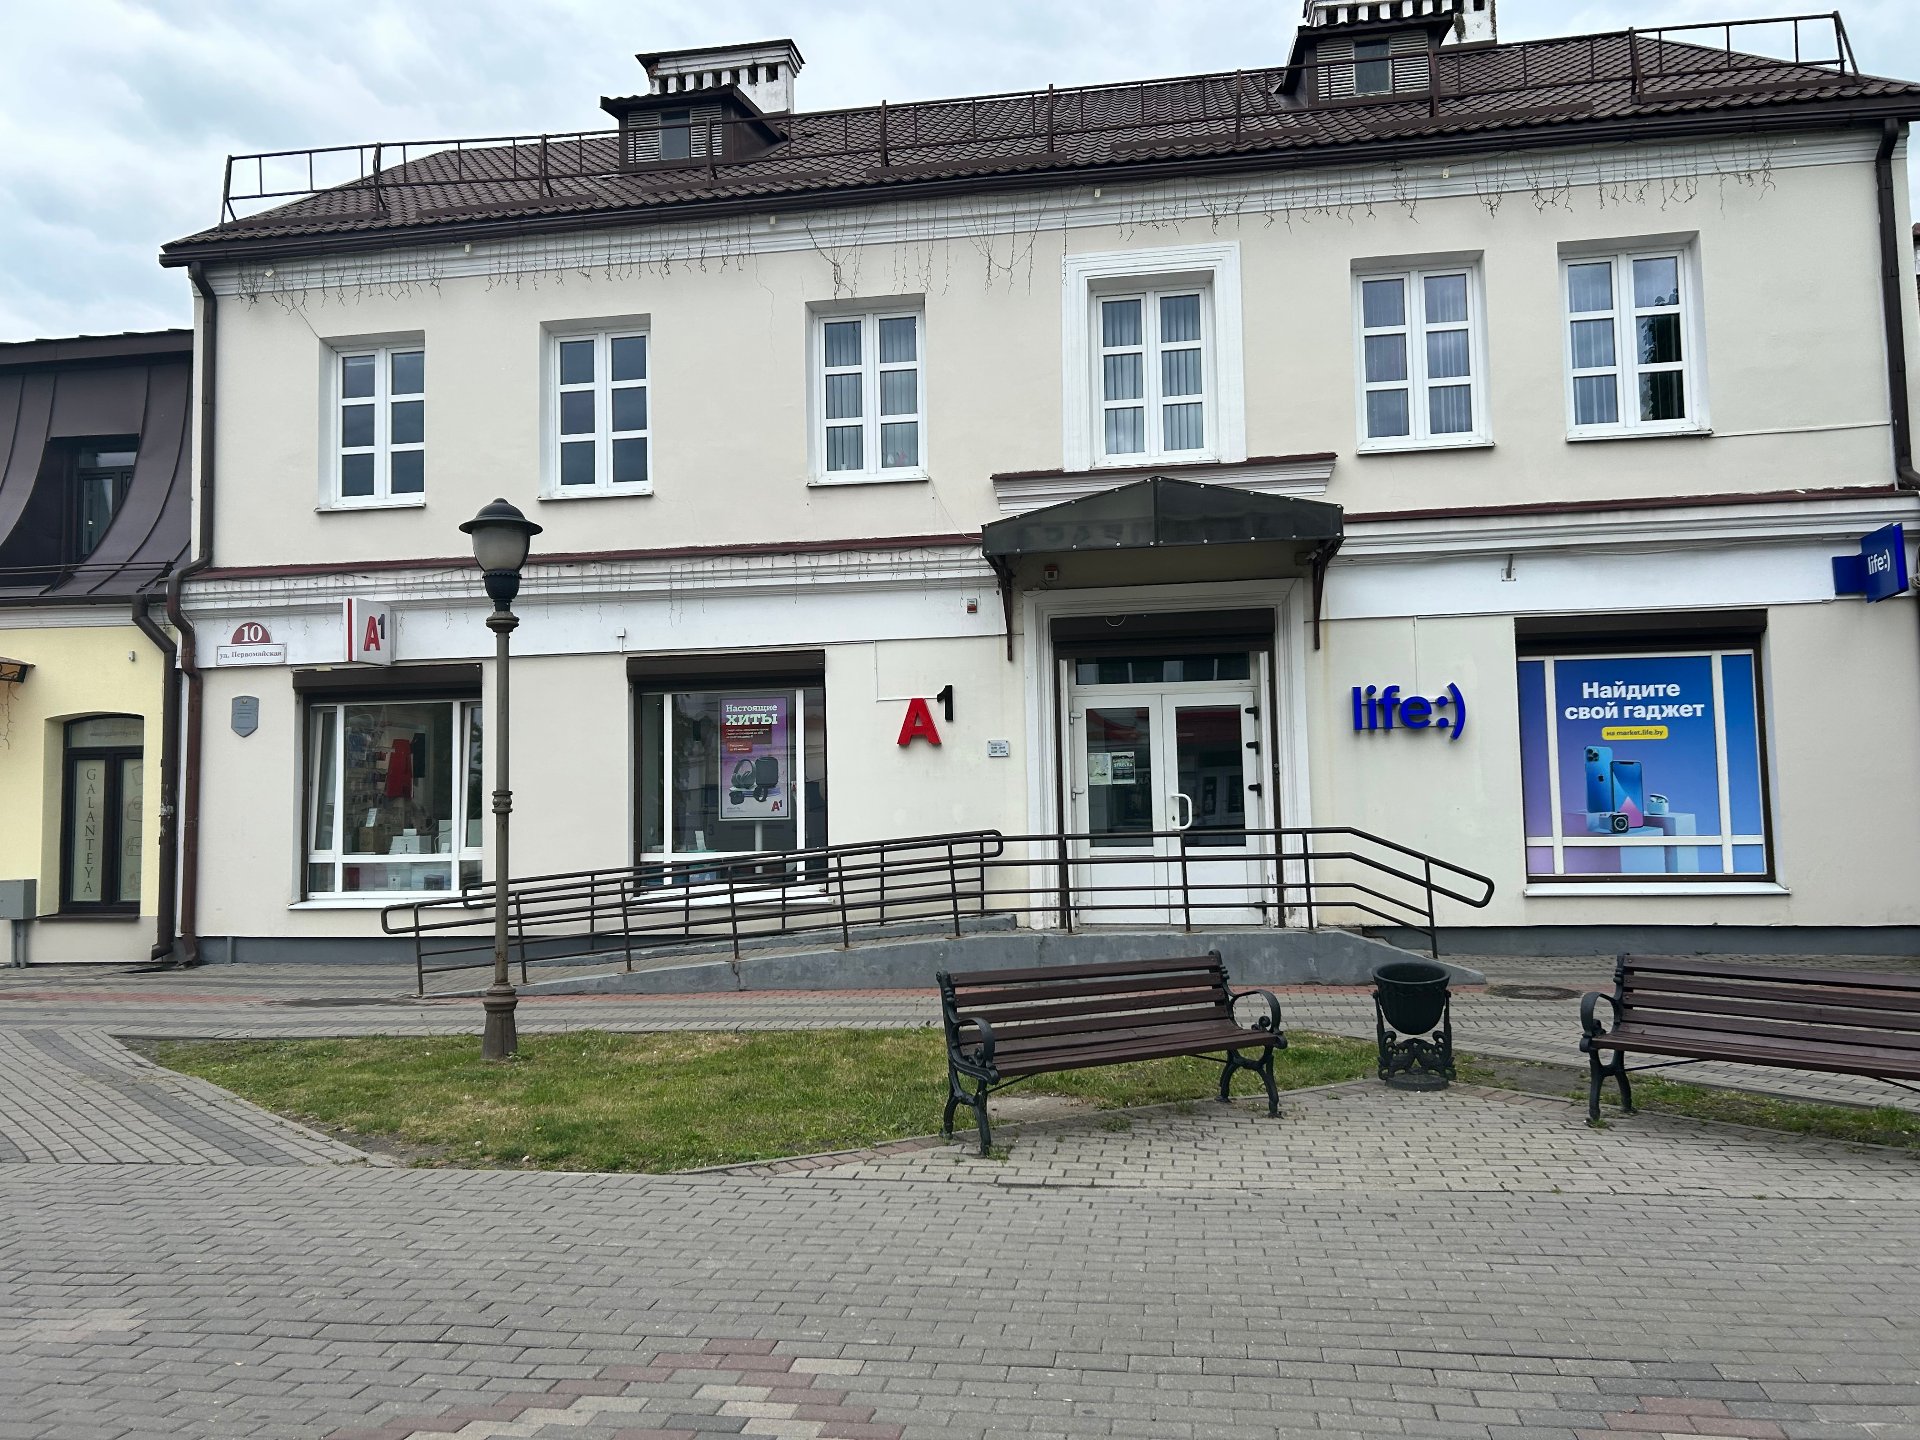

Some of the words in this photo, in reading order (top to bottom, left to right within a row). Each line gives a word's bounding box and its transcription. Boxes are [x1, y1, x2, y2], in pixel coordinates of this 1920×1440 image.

[1867, 548, 1891, 575] life:)
[241, 624, 263, 642] 10
[363, 613, 386, 652] A1
[231, 650, 282, 659] Первомайская
[1582, 680, 1681, 700] Найдите
[725, 704, 778, 713] Настоящие
[896, 684, 954, 746] A1
[1351, 682, 1466, 741] life:)
[1564, 701, 1619, 720] свой
[1623, 703, 1705, 721] гаджет
[1616, 729, 1664, 737] market.life.by
[82, 768, 97, 893] GALANTEYA
